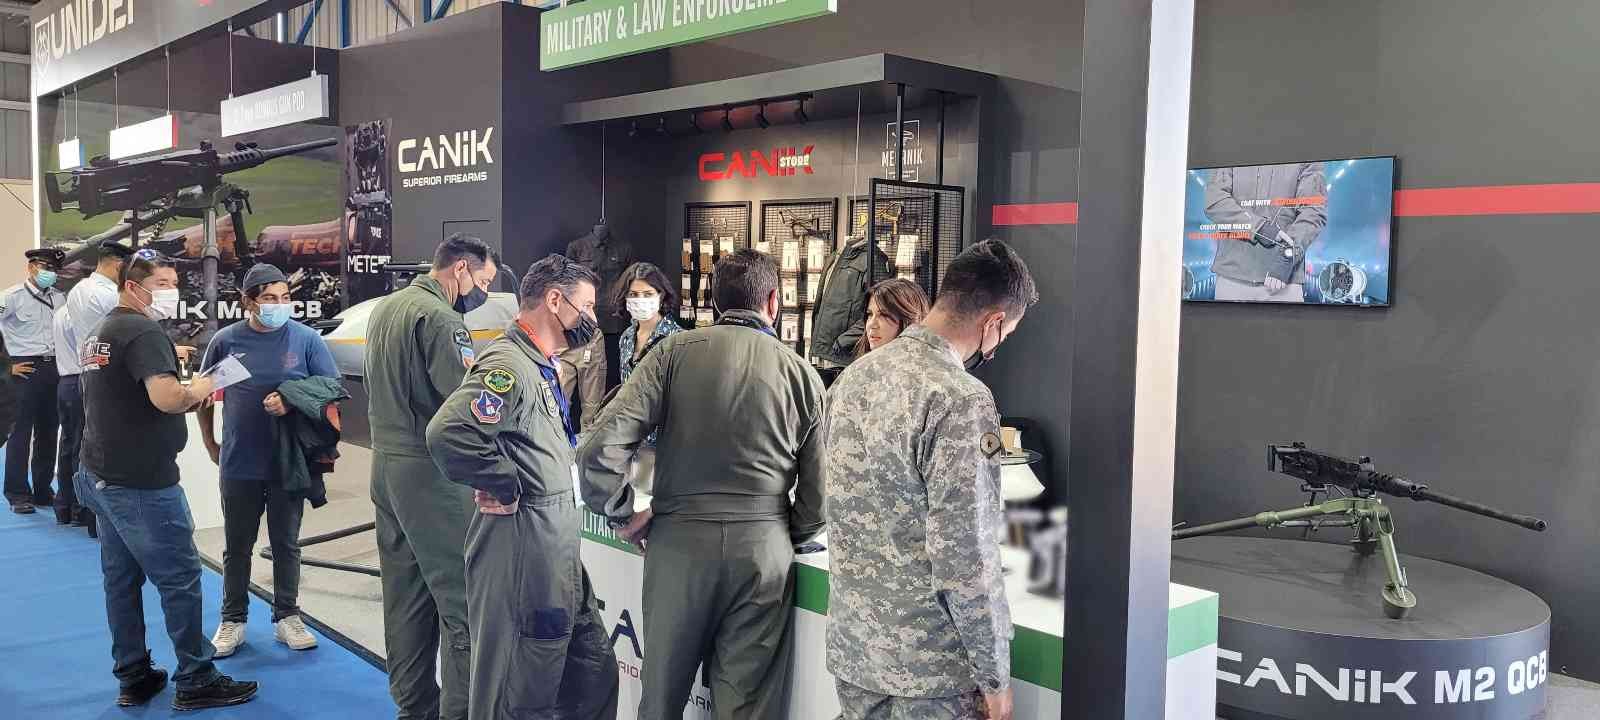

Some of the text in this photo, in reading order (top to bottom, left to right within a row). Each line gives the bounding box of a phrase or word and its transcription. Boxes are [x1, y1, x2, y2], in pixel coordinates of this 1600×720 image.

[547, 8, 612, 55] MILITARY
[616, 6, 627, 39] &
[633, 0, 665, 35] LAW
[780, 154, 810, 168] STORE
[403, 171, 488, 188] SUPERIOR FIREARMS
[1434, 666, 1495, 704] M2
[1507, 649, 1547, 695] QCB
